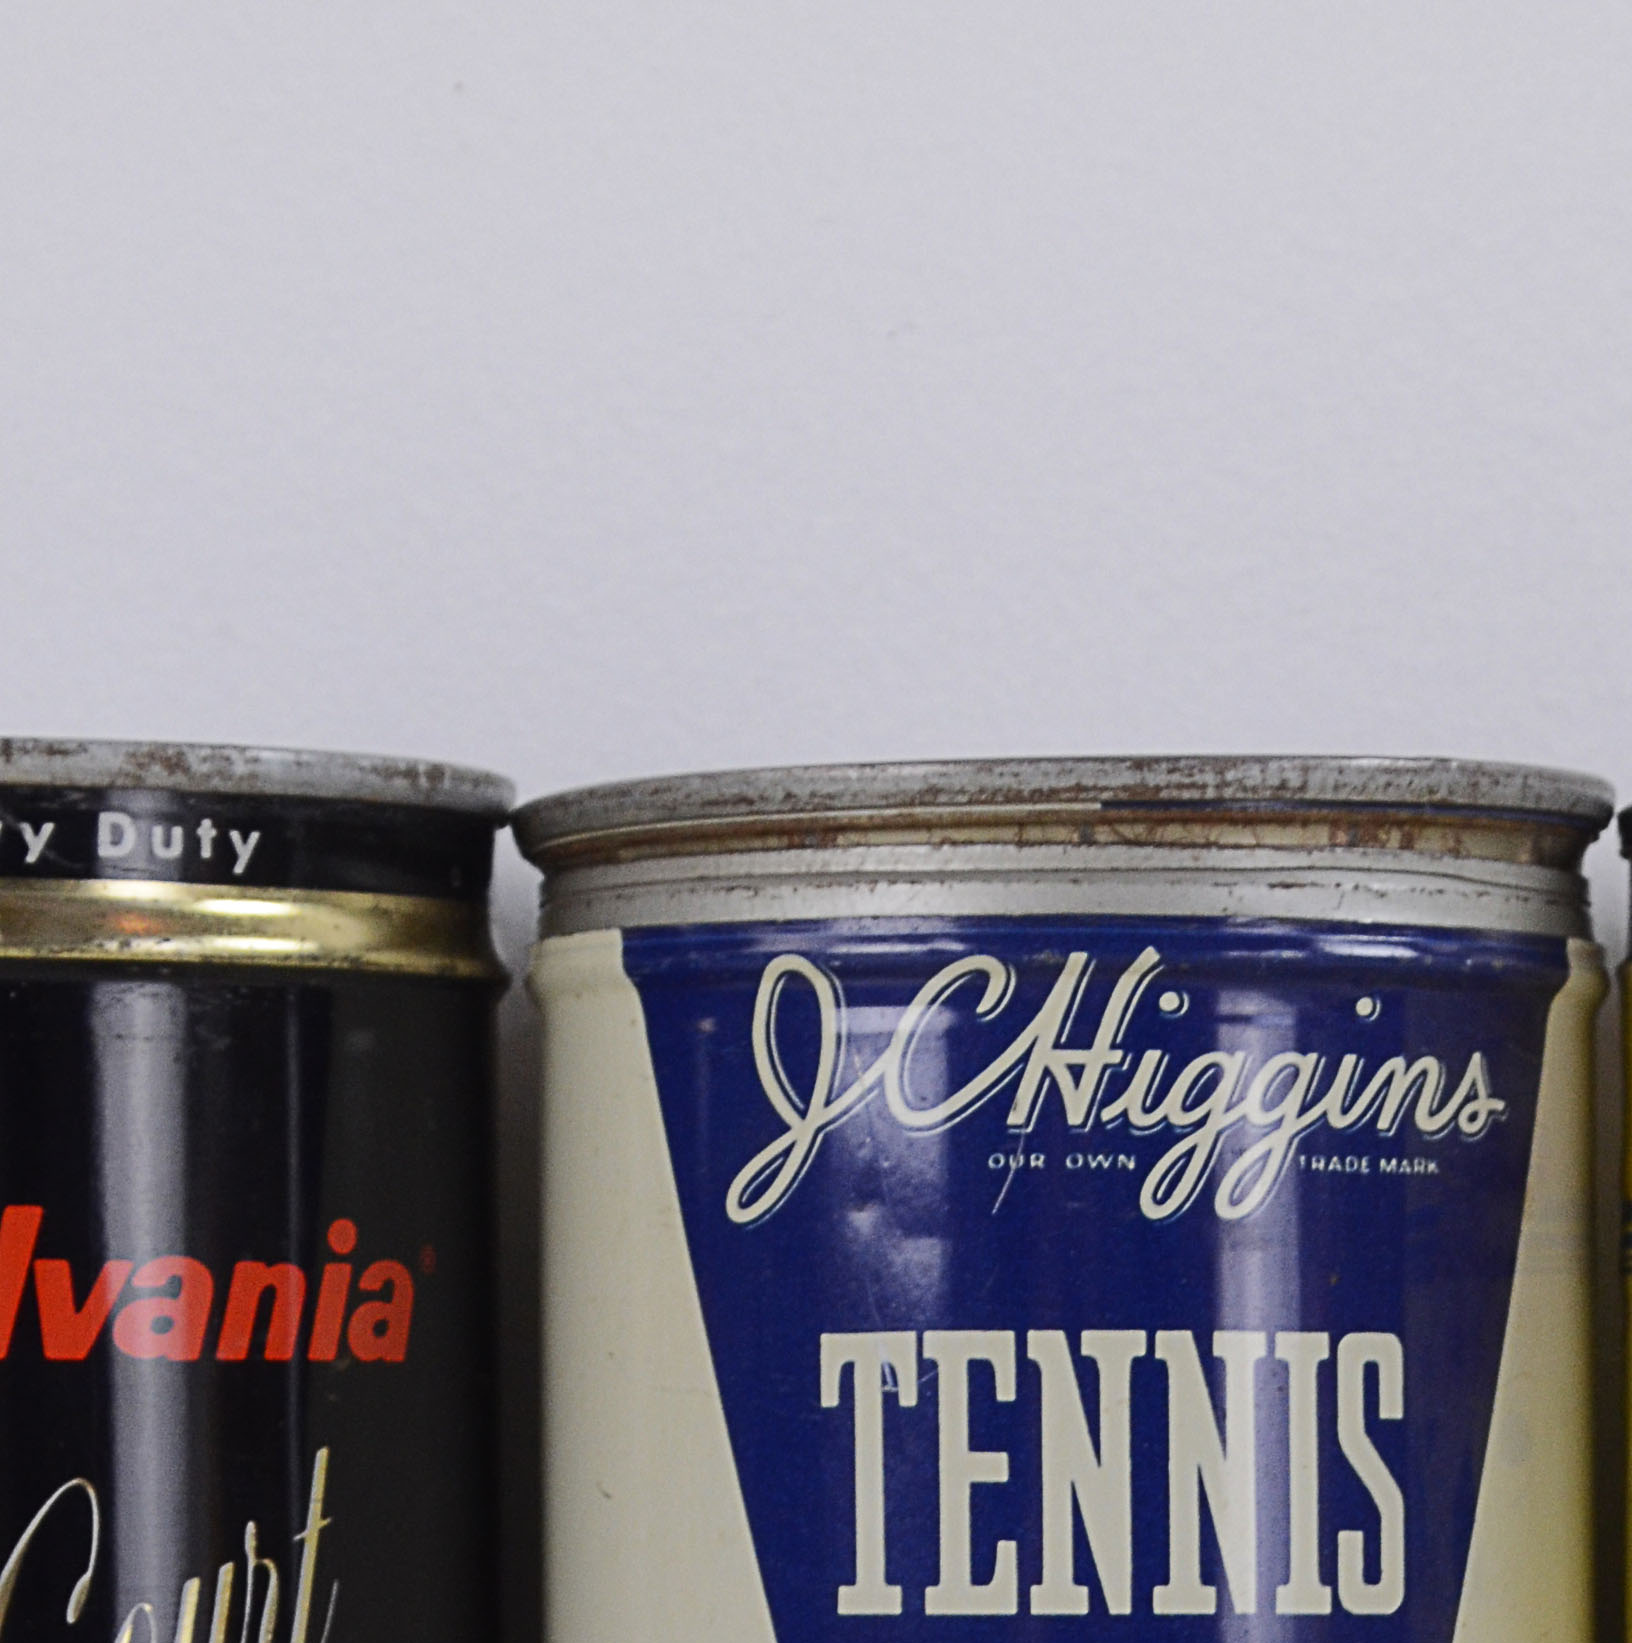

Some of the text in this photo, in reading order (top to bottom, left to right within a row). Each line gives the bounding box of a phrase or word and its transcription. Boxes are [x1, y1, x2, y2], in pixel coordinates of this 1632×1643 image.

[0, 812, 261, 874] y Duty
[988, 1153, 1046, 1170] OUR
[1065, 1154, 1137, 1170] OWN
[1379, 1156, 1441, 1175] MARK
[820, 1328, 1405, 1617] TENNIS
